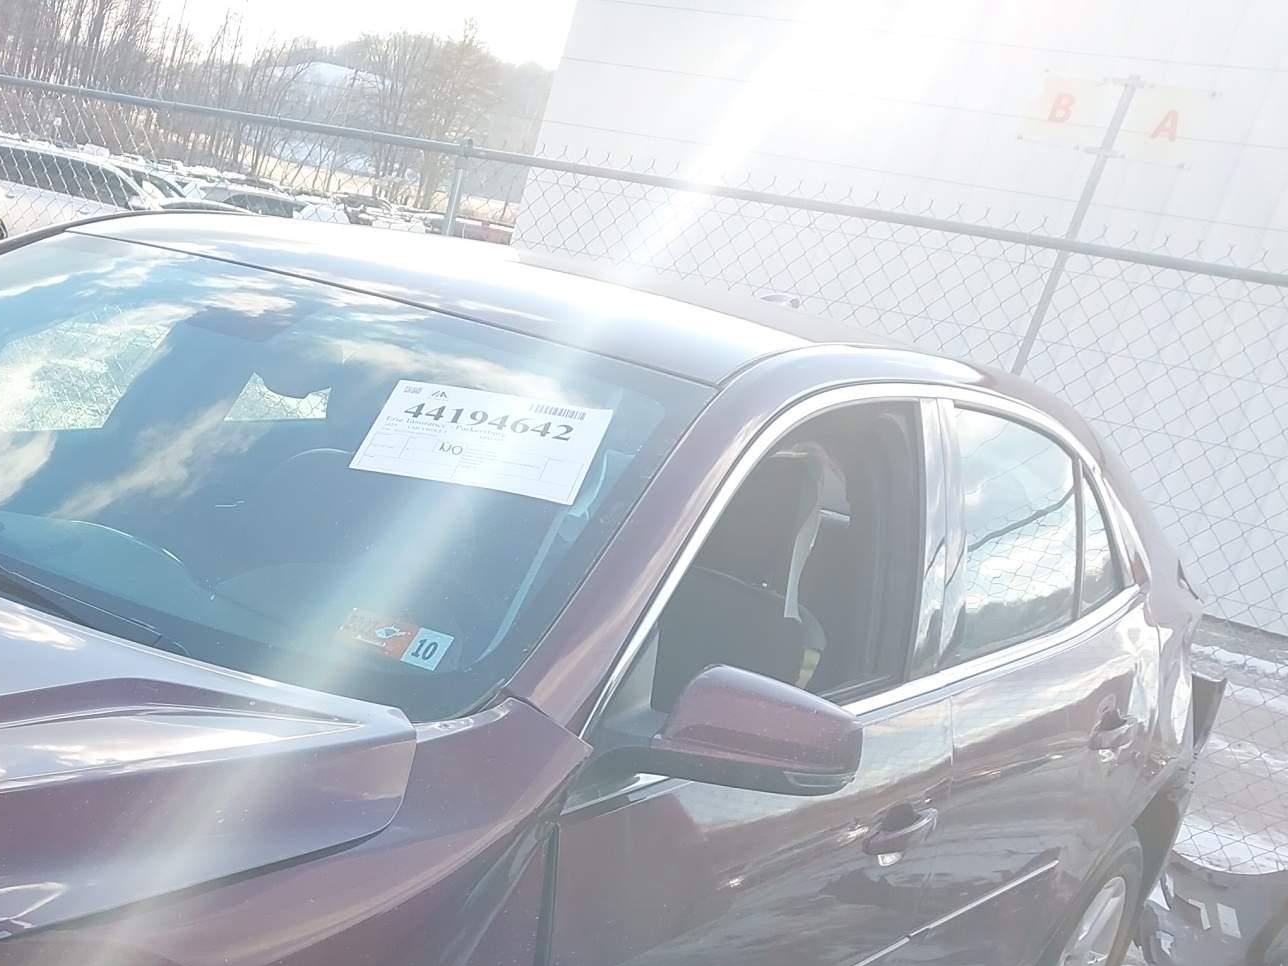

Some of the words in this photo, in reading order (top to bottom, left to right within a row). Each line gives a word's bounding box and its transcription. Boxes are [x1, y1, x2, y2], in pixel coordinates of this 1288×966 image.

[1047, 92, 1076, 123] B
[1150, 109, 1179, 142] A
[403, 402, 574, 442] 44194642
[410, 638, 439, 661] 10
